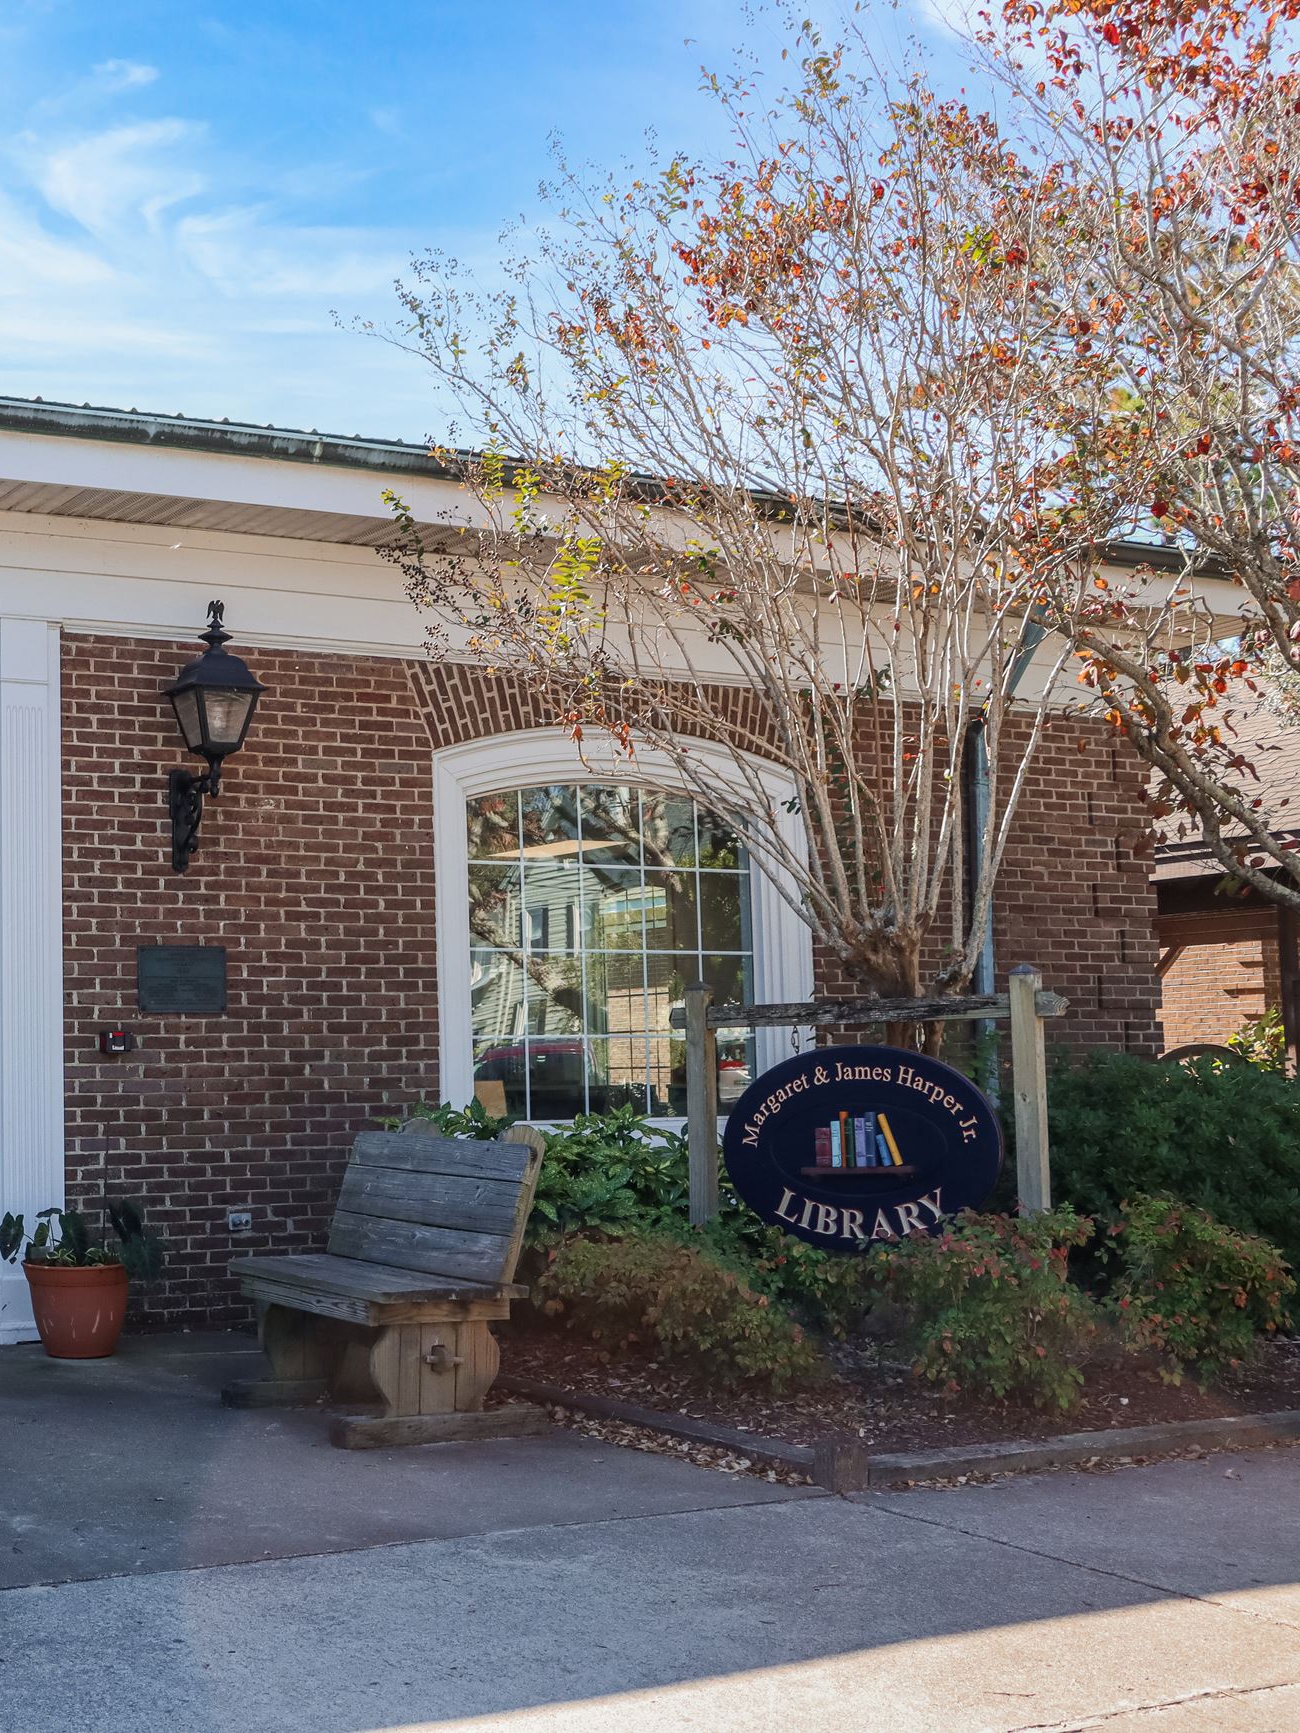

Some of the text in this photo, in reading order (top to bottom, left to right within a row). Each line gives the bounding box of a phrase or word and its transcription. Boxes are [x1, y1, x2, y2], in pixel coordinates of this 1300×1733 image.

[742, 1062, 978, 1148] Margaret & James Harper Jr.
[774, 1186, 944, 1240] LIBRARY
